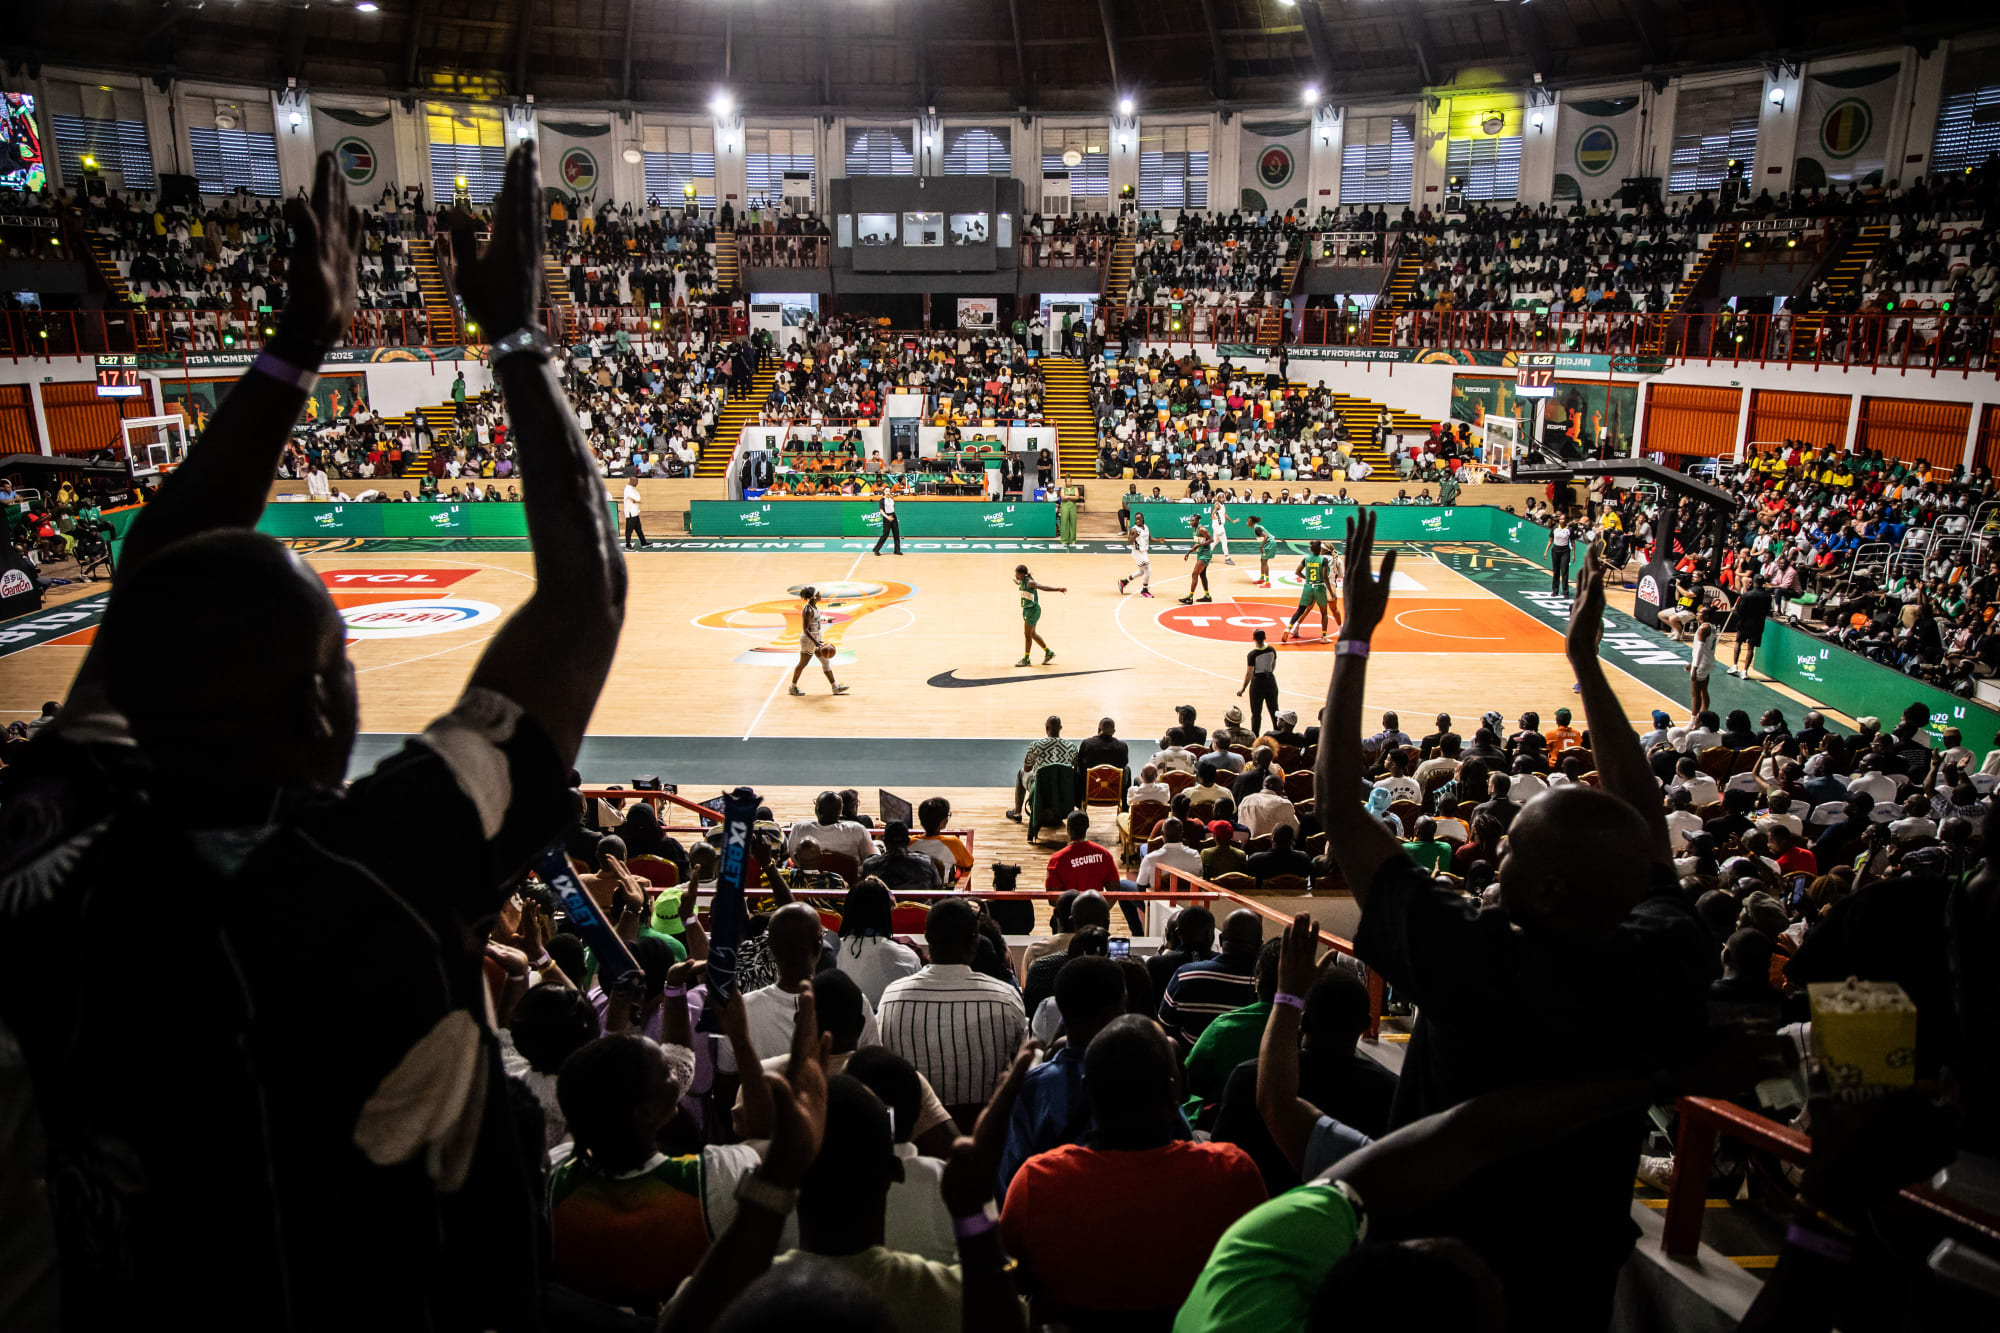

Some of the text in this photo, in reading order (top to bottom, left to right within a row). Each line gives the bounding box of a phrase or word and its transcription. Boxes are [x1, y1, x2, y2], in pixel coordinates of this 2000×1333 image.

[331, 352, 354, 360] 2025
[1321, 350, 1376, 358] AFROBASKET
[1533, 355, 1553, 364] 6:27
[186, 356, 209, 364] FIBA
[98, 371, 137, 386] 17 17
[1530, 370, 1552, 386] 17
[334, 574, 438, 583] TCL
[1310, 568, 1317, 581] 2
[1172, 615, 1323, 628] TCL
[1070, 853, 1103, 868] SECURITY
